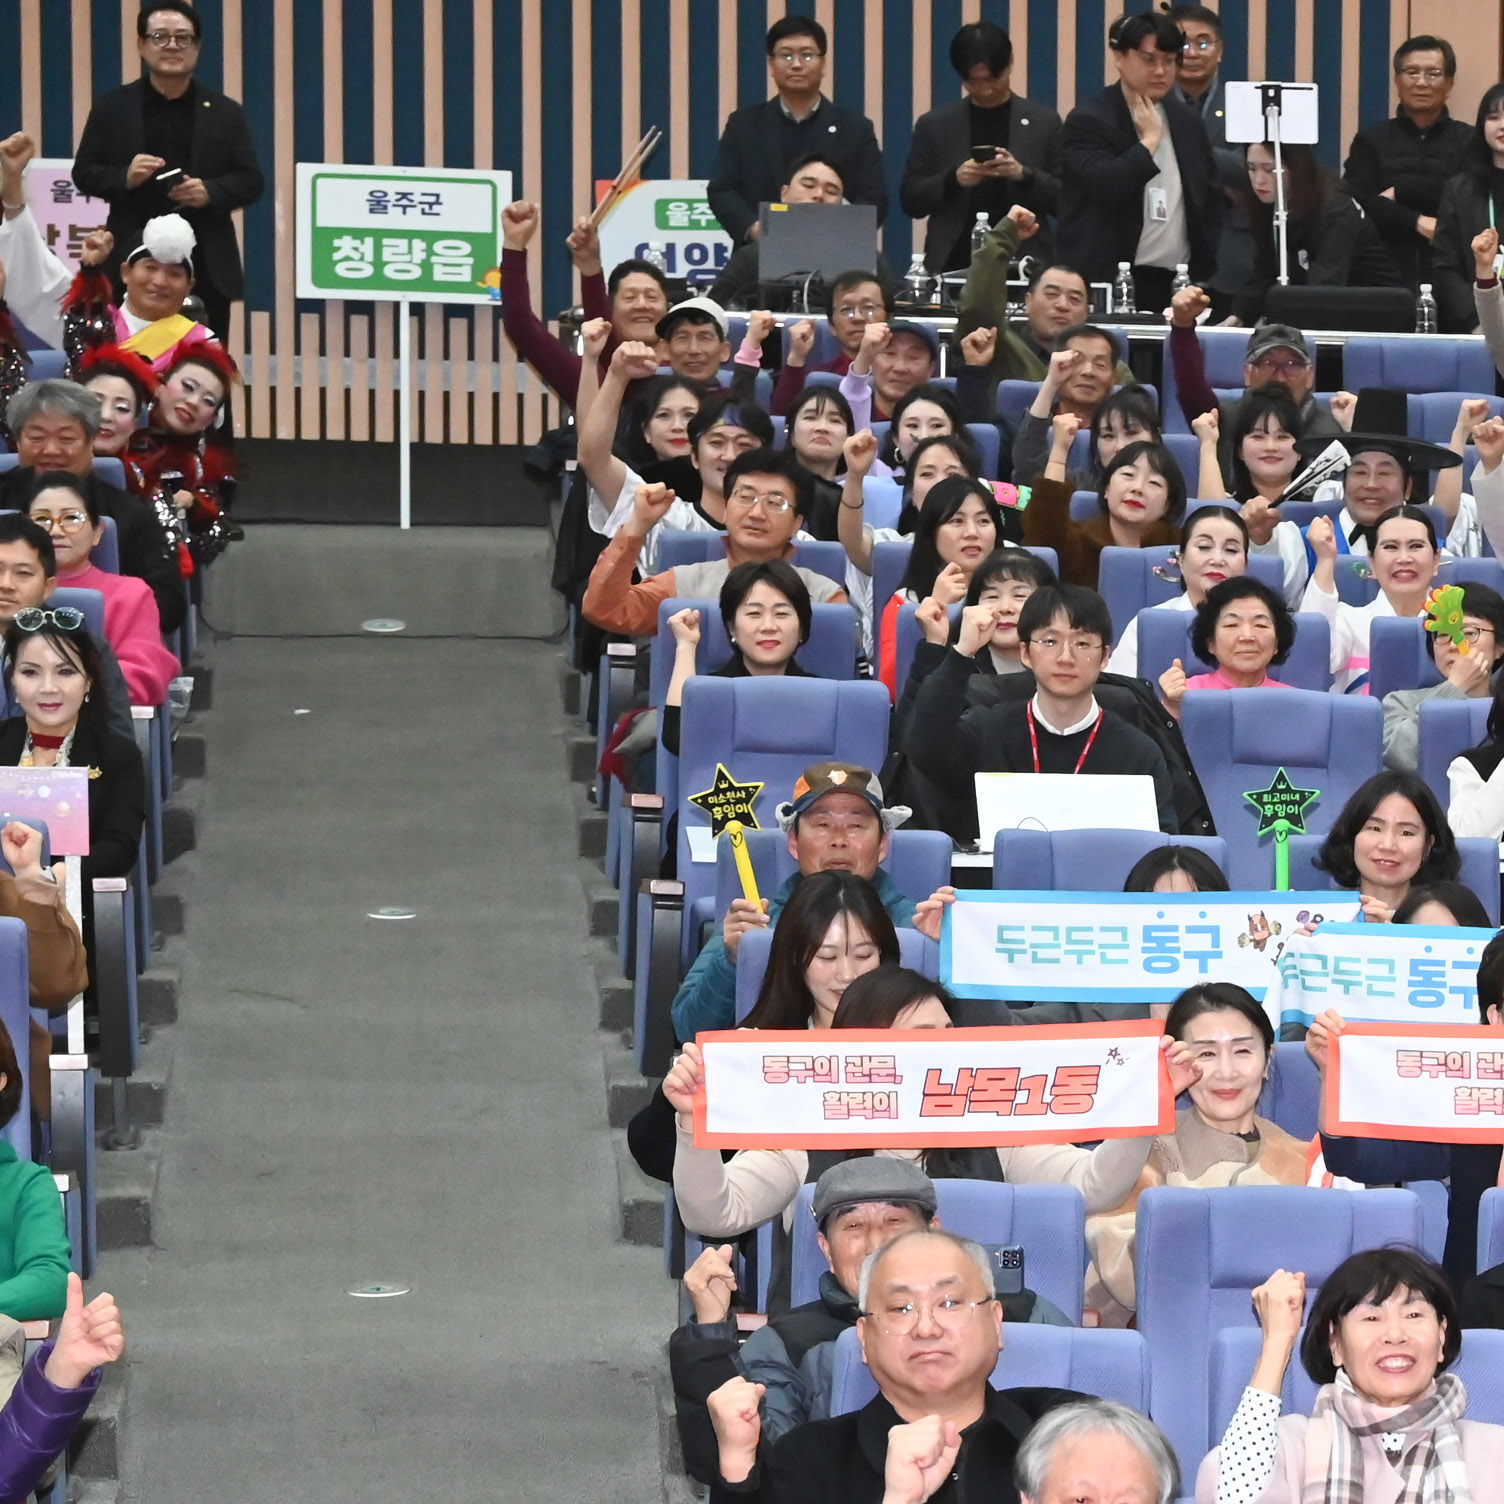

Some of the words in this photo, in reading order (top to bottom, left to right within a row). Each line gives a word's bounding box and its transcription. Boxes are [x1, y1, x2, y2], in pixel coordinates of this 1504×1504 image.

[366, 190, 443, 216] 울주군
[332, 235, 474, 282] 청량읍
[995, 925, 1130, 965] 두근두근
[1141, 923, 1223, 974] 동구
[1407, 958, 1480, 1010] 동구
[762, 1055, 839, 1084] 동구의
[1395, 1049, 1471, 1080] 동구의
[823, 1091, 898, 1120] 활력의
[919, 1065, 1102, 1117] 남목1동
